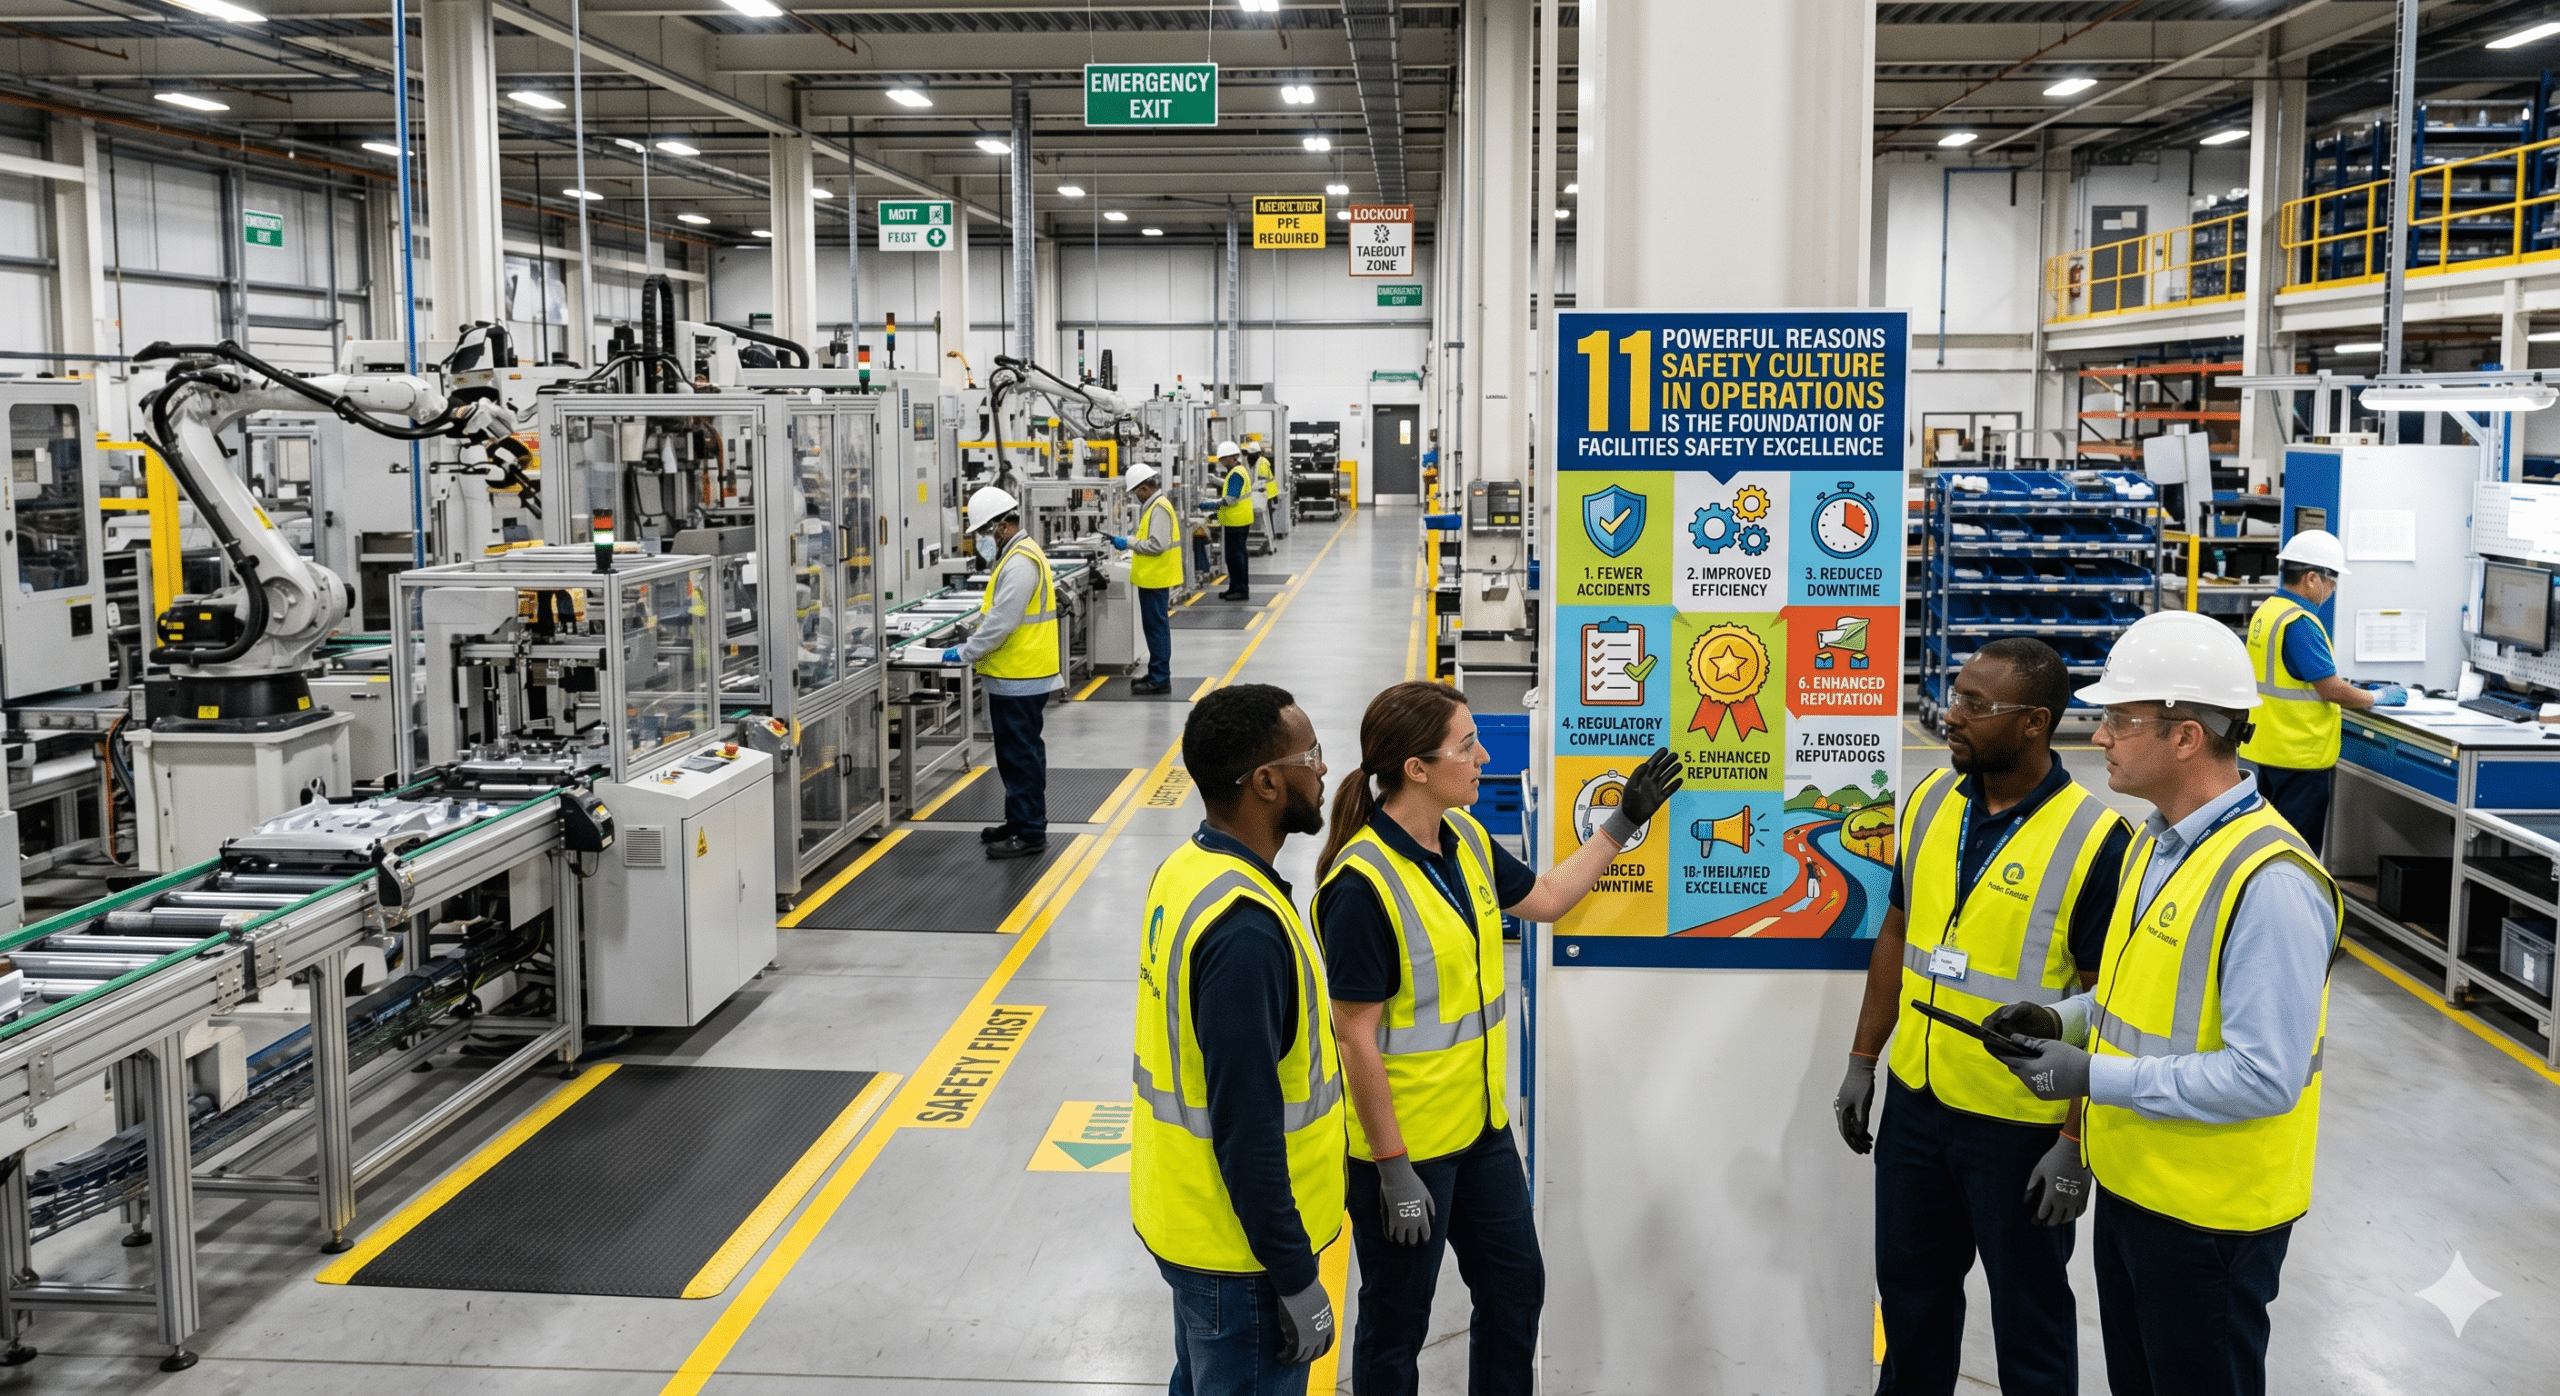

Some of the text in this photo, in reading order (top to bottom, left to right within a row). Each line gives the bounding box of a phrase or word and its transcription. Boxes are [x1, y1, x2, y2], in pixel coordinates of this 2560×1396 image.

[1091, 72, 1211, 93] EMERGENCY
[1130, 98, 1173, 119] EXIT
[1353, 208, 1409, 221] LOCKOUT
[1277, 217, 1300, 229] PPE
[1259, 232, 1319, 244] REQUIRED
[1366, 259, 1397, 271] ZONE
[1662, 327, 1886, 349] POWERFUL REASONS
[1661, 352, 1885, 379] SAFETY CULTURE
[1577, 329, 1652, 432] 11
[1662, 380, 1885, 410] IN OPERATIONS
[1661, 413, 1885, 433] IS THE FOUNDATION OF
[1578, 436, 1884, 457] FACILITIES SAFETY EXCELLENCE
[1584, 566, 1643, 580] 1. FEWER
[1687, 567, 1772, 580] 2. IMPROVED
[1805, 566, 1883, 581] 3. REDUCED
[1576, 583, 1651, 597] ACCIDENTS
[1692, 583, 1768, 597] EFFICIENCY
[1807, 583, 1881, 597] DOWNTIME
[1798, 676, 1886, 690] 6. ENHANCED
[1800, 692, 1883, 706] REPUTATION
[1561, 716, 1663, 730] 4. REGULATORY
[1569, 732, 1655, 747] COMPLIANCE
[1803, 733, 1814, 746] 7.
[1684, 750, 1771, 764] 5. ENHANCED
[1795, 749, 1886, 763] REPUTADOGS
[1687, 766, 1768, 780] REPUTATION
[1591, 880, 1654, 893] OWNTIME
[1685, 880, 1768, 895] EXCELLENCE
[916, 1009, 1033, 1123] SAFETY FIRST
